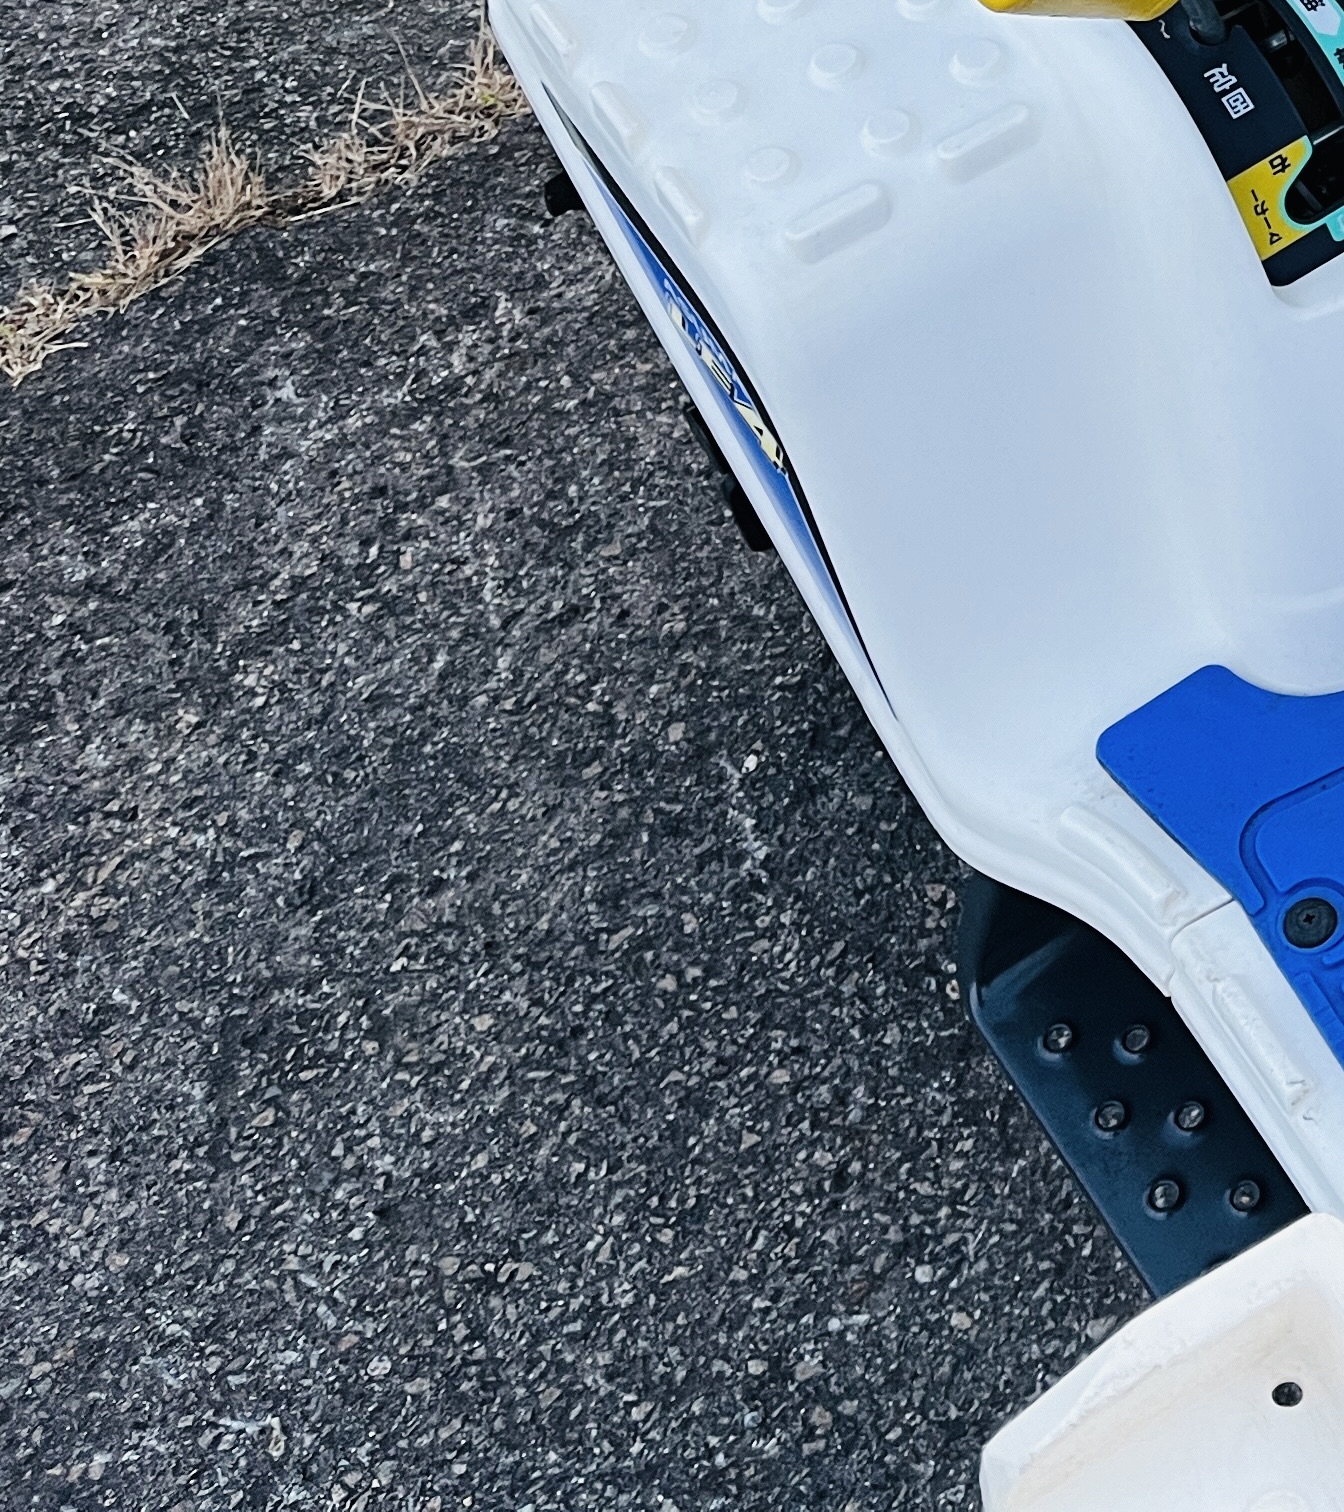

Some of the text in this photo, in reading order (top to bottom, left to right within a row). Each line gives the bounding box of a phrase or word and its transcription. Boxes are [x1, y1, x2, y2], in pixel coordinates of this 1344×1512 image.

[1204, 63, 1254, 120] 固定
[1269, 154, 1291, 177] 右
[1250, 188, 1281, 246] マーカー
